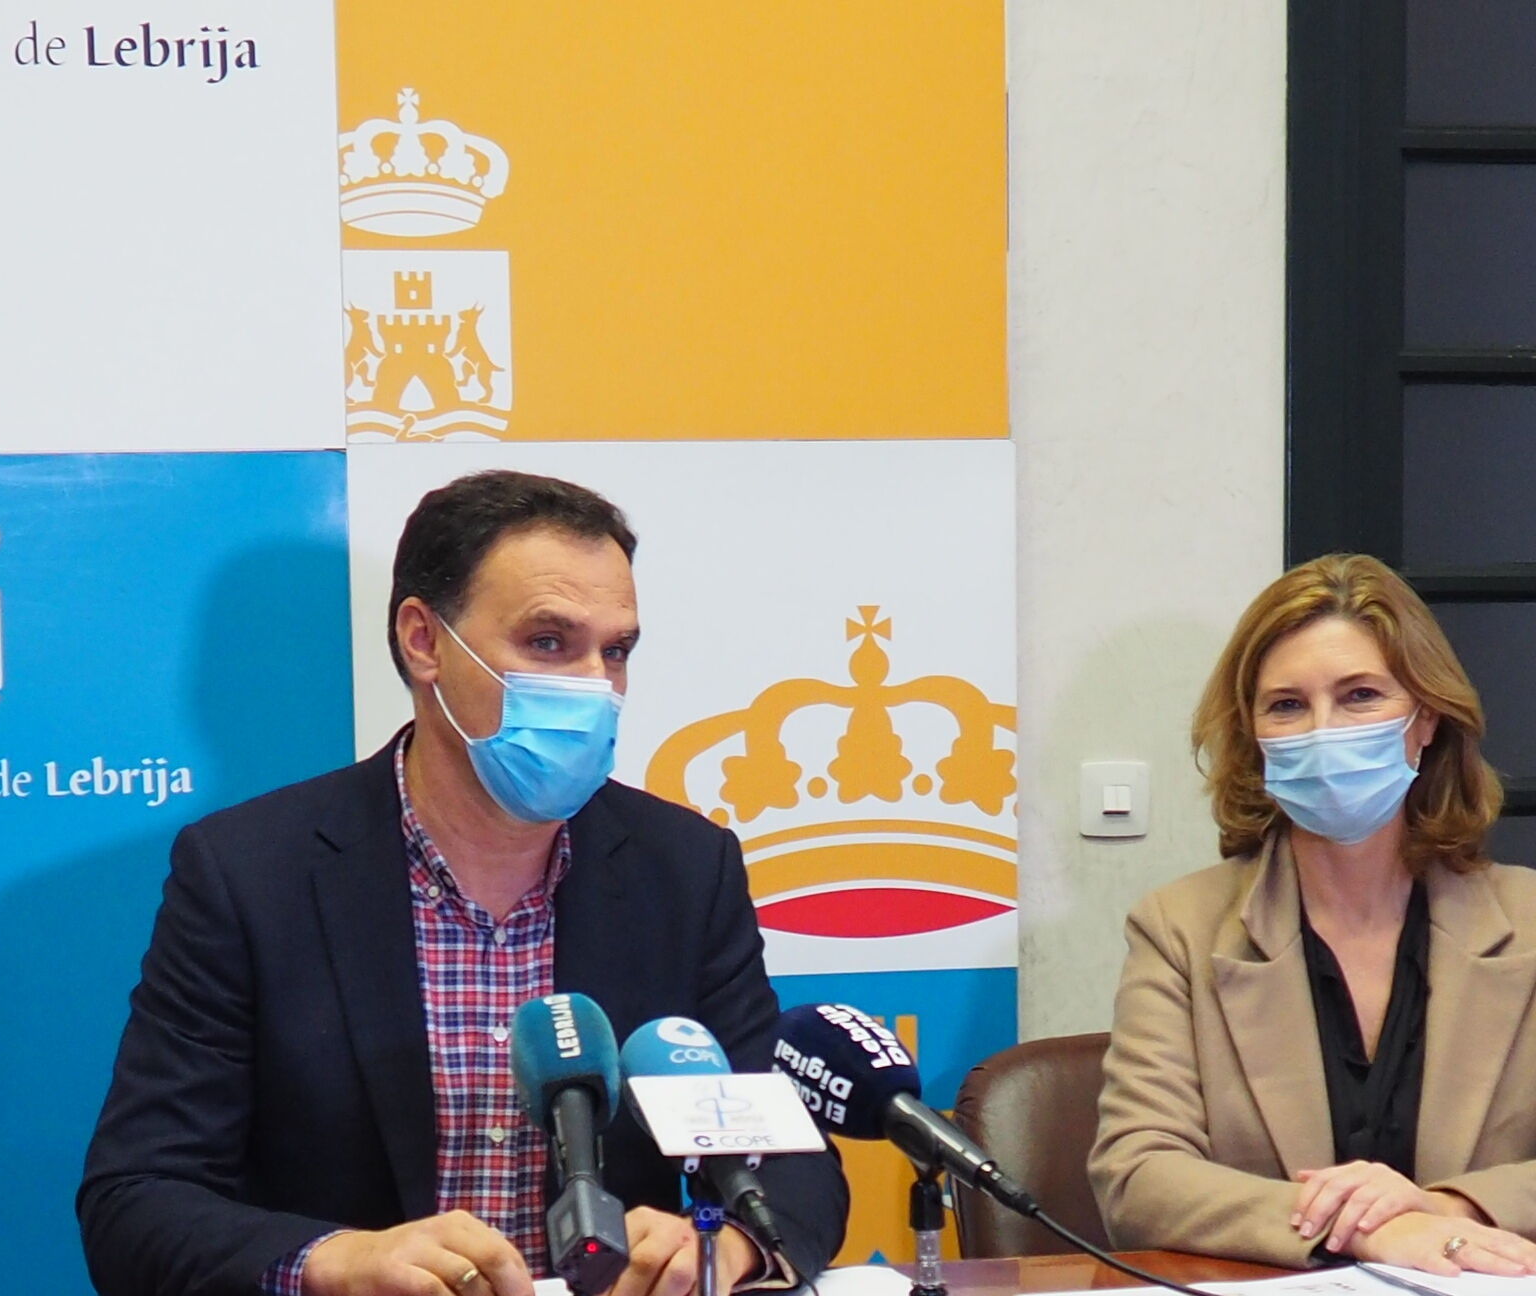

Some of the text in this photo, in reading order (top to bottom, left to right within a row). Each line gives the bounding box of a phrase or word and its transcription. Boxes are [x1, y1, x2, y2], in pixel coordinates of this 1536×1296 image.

[14, 20, 67, 67] de
[84, 22, 262, 84] Lebrija
[44, 756, 195, 808] Lebrija
[669, 1048, 723, 1068] COPE
[773, 1038, 854, 1101] Digital
[824, 1099, 847, 1125] El
[718, 1134, 777, 1148] COPE
